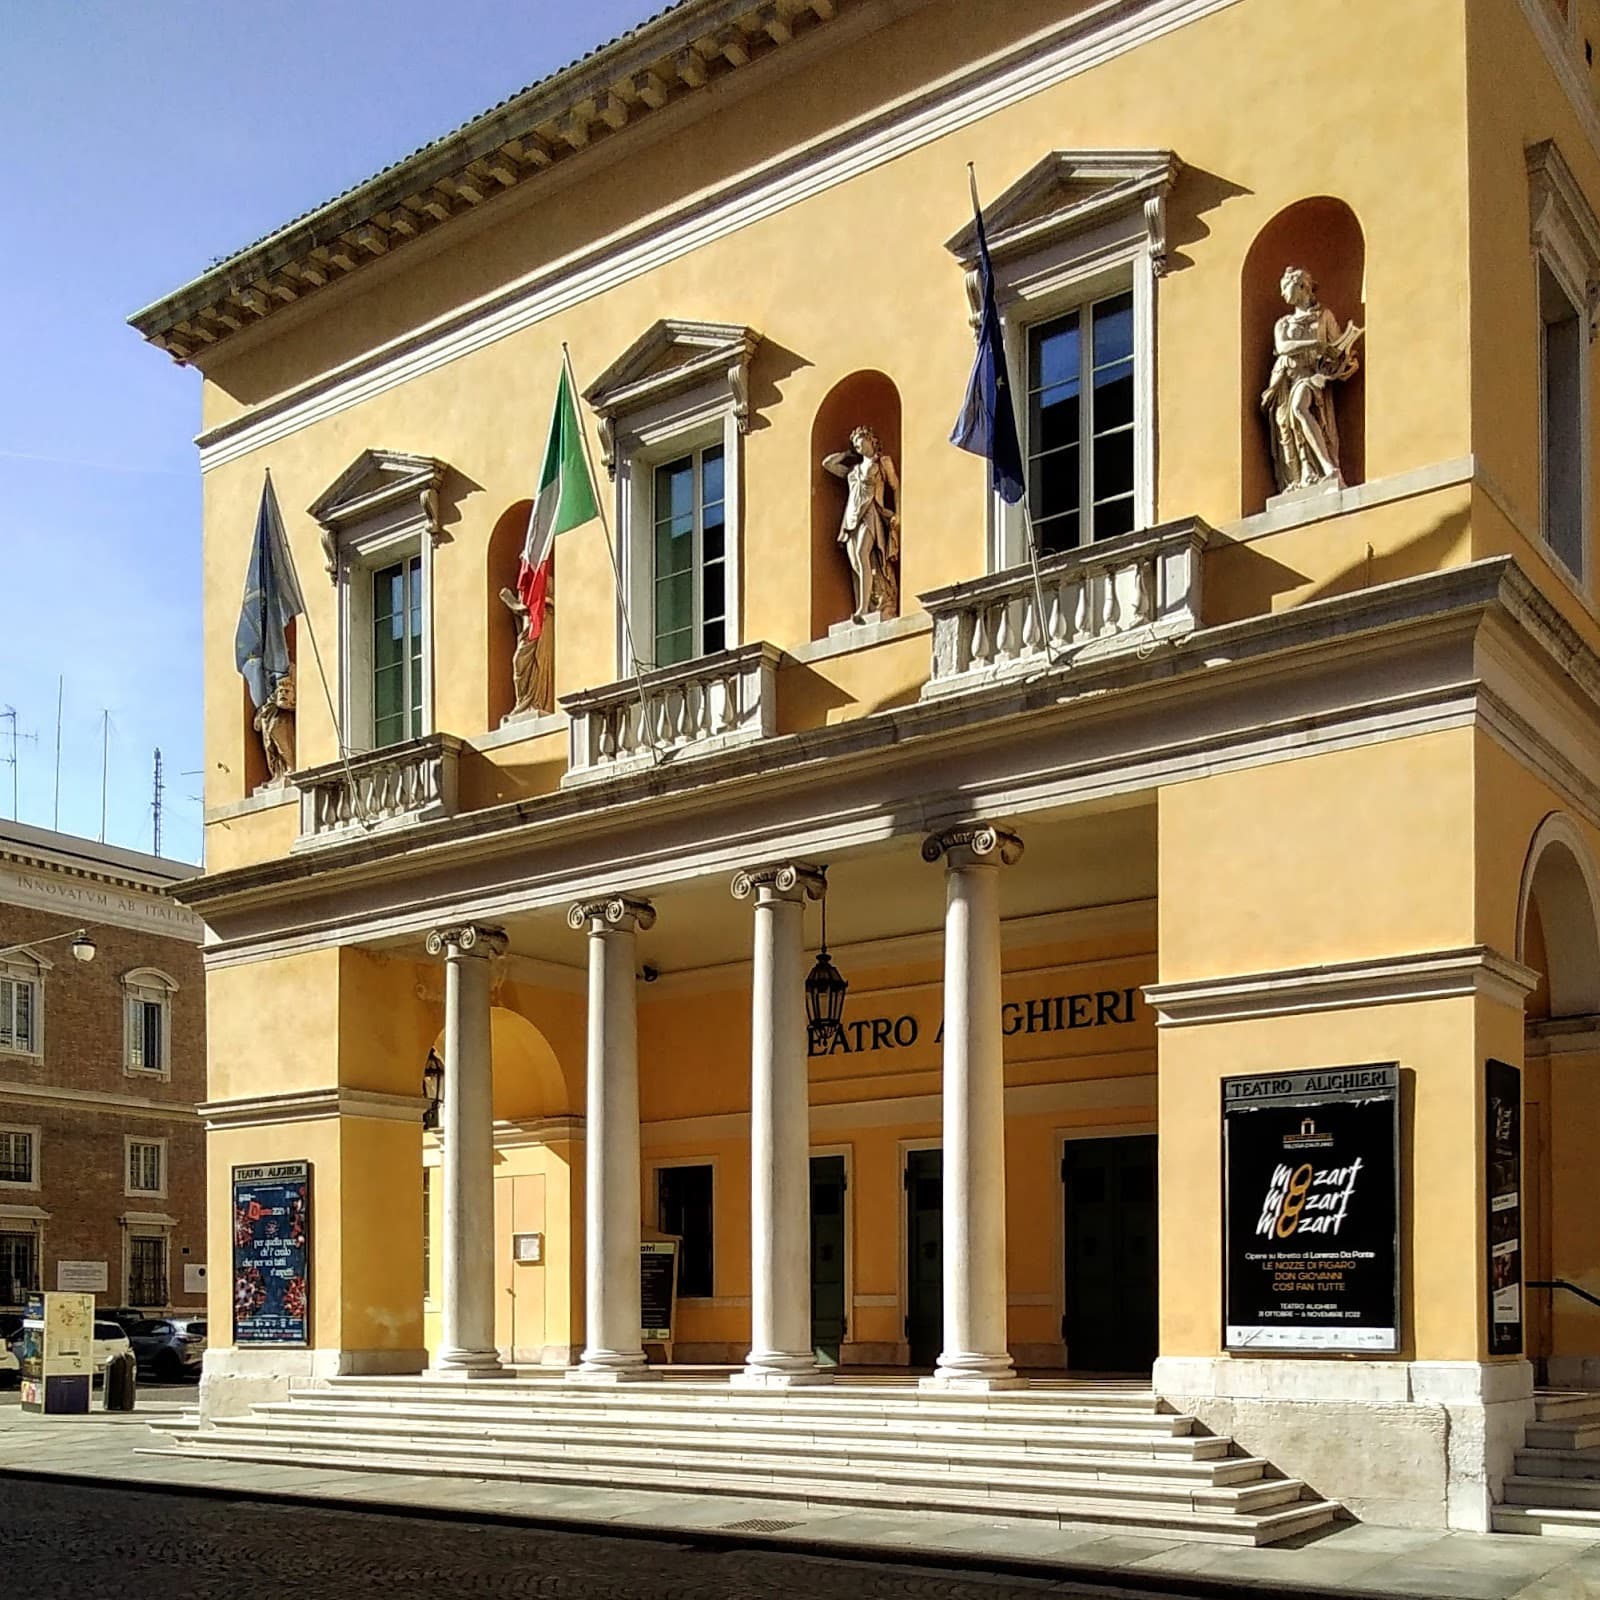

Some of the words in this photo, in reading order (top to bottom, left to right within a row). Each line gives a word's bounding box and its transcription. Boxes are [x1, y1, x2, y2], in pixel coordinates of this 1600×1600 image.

[118, 900, 135, 911] AB
[807, 1016, 918, 1057] EATRO
[1232, 1079, 1293, 1097] TEATRO
[1305, 1070, 1388, 1091] ALIGHIERI
[1262, 1261, 1273, 1270] LE
[1275, 1261, 1305, 1270] NOZZE
[1307, 1261, 1316, 1269] DI
[1318, 1260, 1356, 1269] FIGARO
[1274, 1272, 1296, 1281] DON
[1298, 1272, 1343, 1280] GIOVANNI
[1296, 1282, 1314, 1291] FAN
[1317, 1282, 1345, 1291] TUTTE
